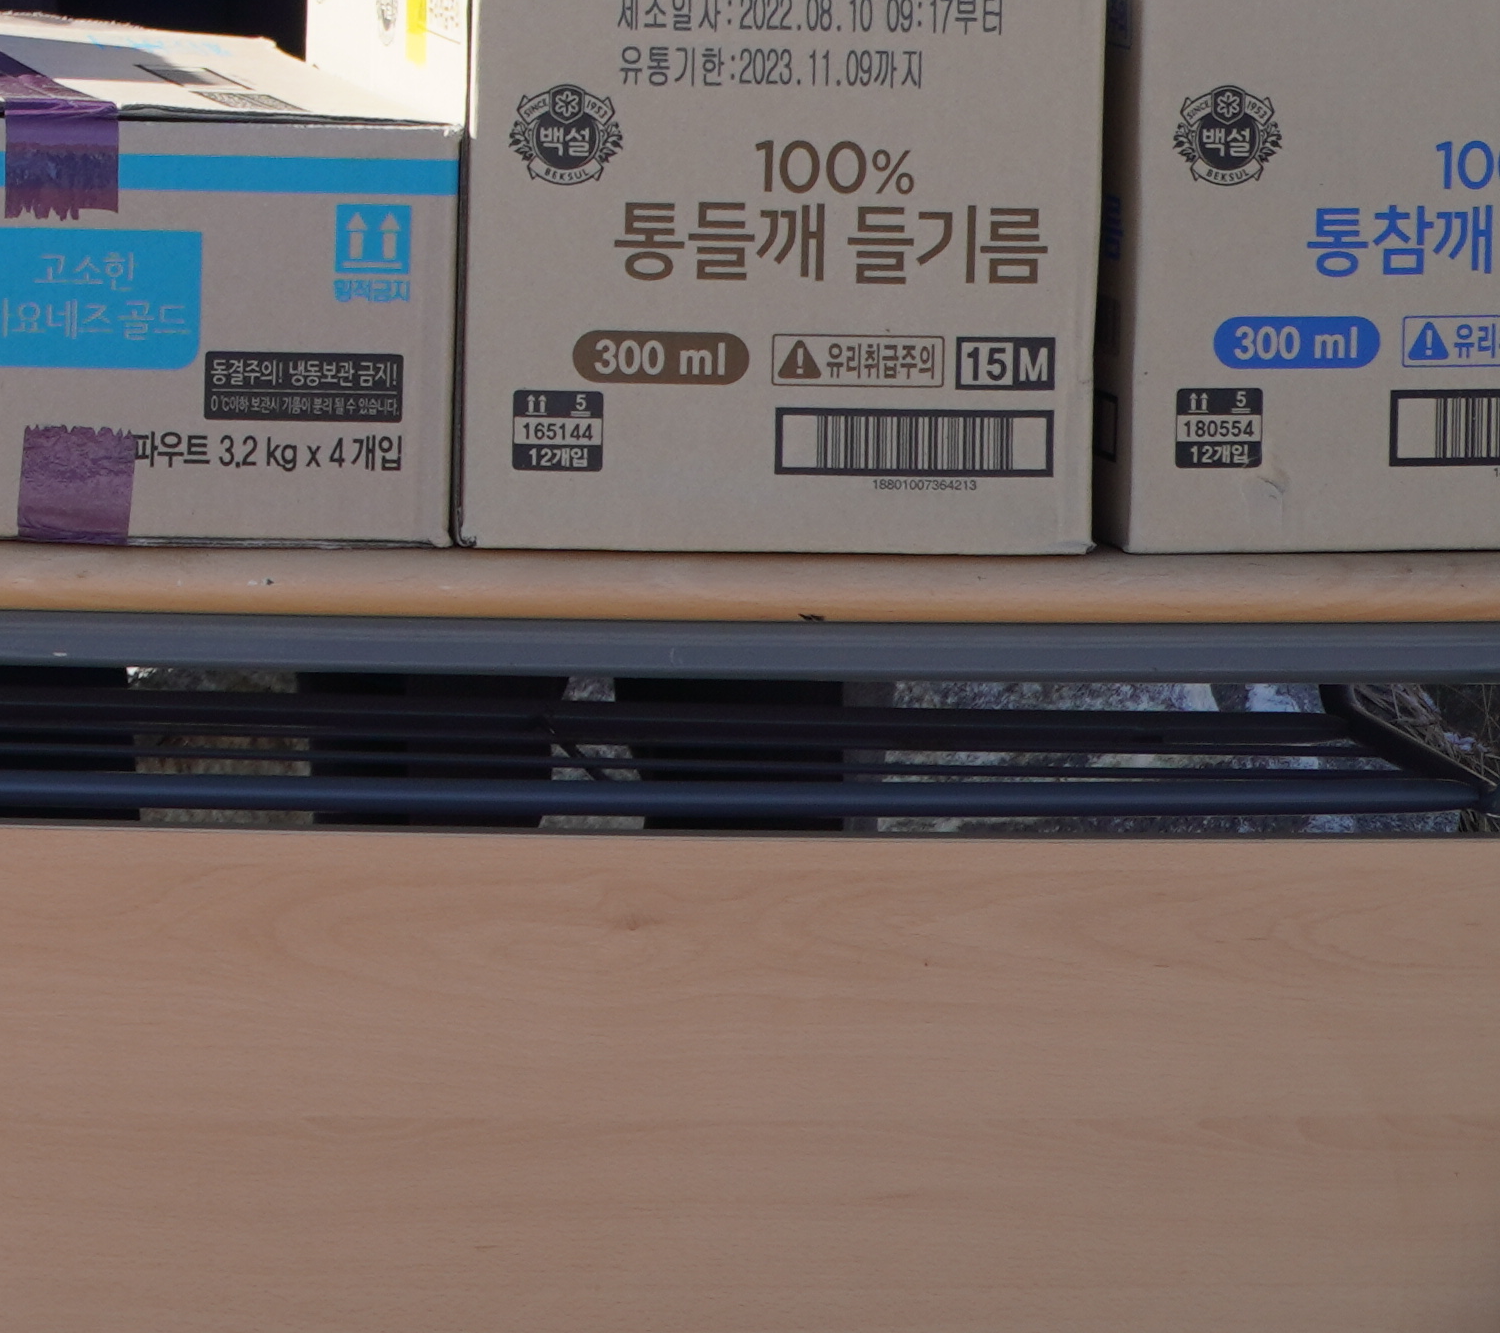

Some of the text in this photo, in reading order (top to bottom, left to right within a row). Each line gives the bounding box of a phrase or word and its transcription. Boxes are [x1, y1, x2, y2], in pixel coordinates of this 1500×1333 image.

[523, 99, 609, 120] SINCE 1953
[1246, 100, 1268, 119] 1953
[539, 123, 590, 157] 백설
[1202, 127, 1251, 158] 백설
[543, 167, 590, 182] BEKSUL
[755, 139, 915, 195] 100%
[1205, 168, 1250, 183] BEKSUL
[614, 201, 1048, 285] 통들깨 들기름
[1306, 205, 1494, 278] 통참깨
[34, 252, 136, 292] 고소한
[594, 338, 726, 376] 300 ml
[1234, 325, 1359, 361] 300 ml
[211, 359, 398, 387] 동결주의! 냉동보관 금지!
[826, 342, 936, 380] 유리취급주의
[521, 422, 594, 443] 165144
[1183, 420, 1255, 438] 180554
[219, 434, 402, 472] 3.2 kg 개입
[528, 447, 589, 469] 12개입
[1190, 444, 1250, 464] 12개입
[872, 478, 977, 492] 18801007364213
